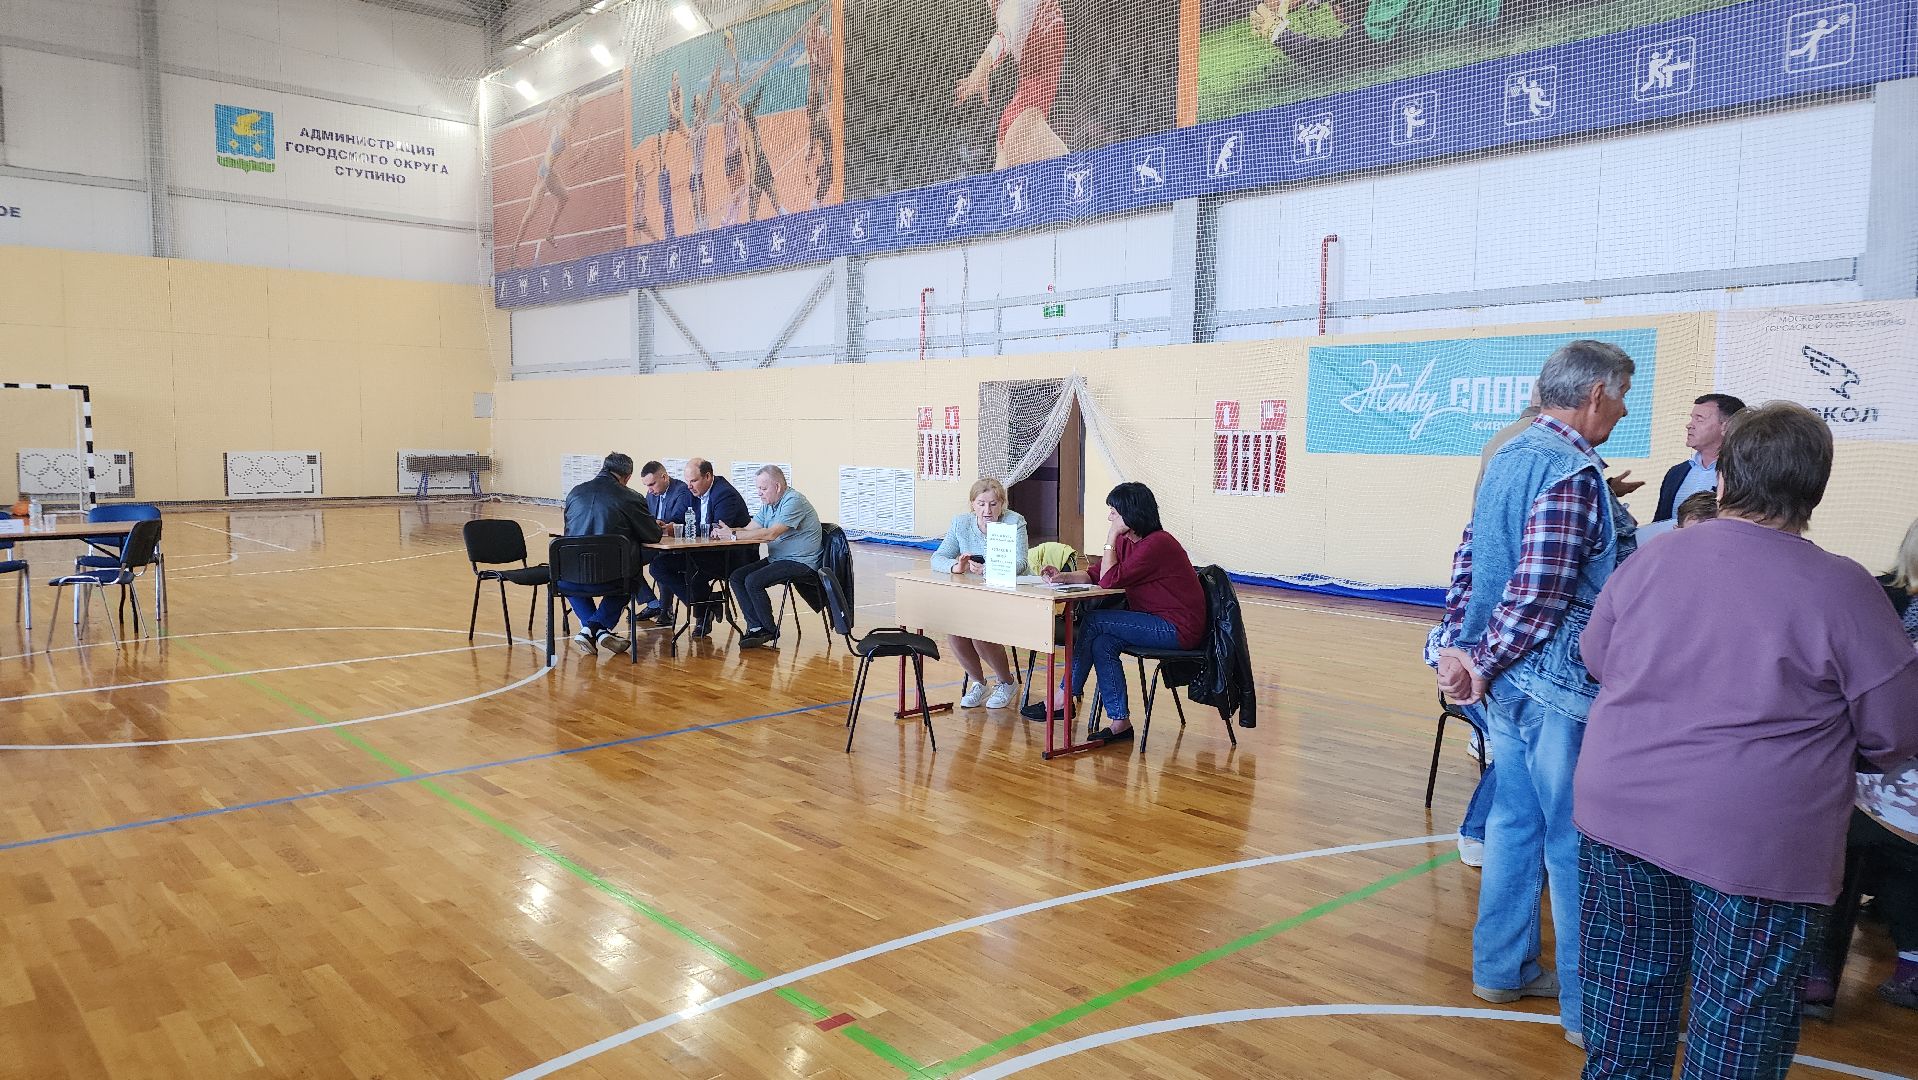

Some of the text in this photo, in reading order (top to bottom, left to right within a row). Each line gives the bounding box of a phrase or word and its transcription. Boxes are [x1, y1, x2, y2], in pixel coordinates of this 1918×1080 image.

[285, 141, 449, 175] ГОРОДСКОГО ОКРУГА
[335, 165, 406, 184] СТУПИНО
[1450, 375, 1540, 414] СПОР
